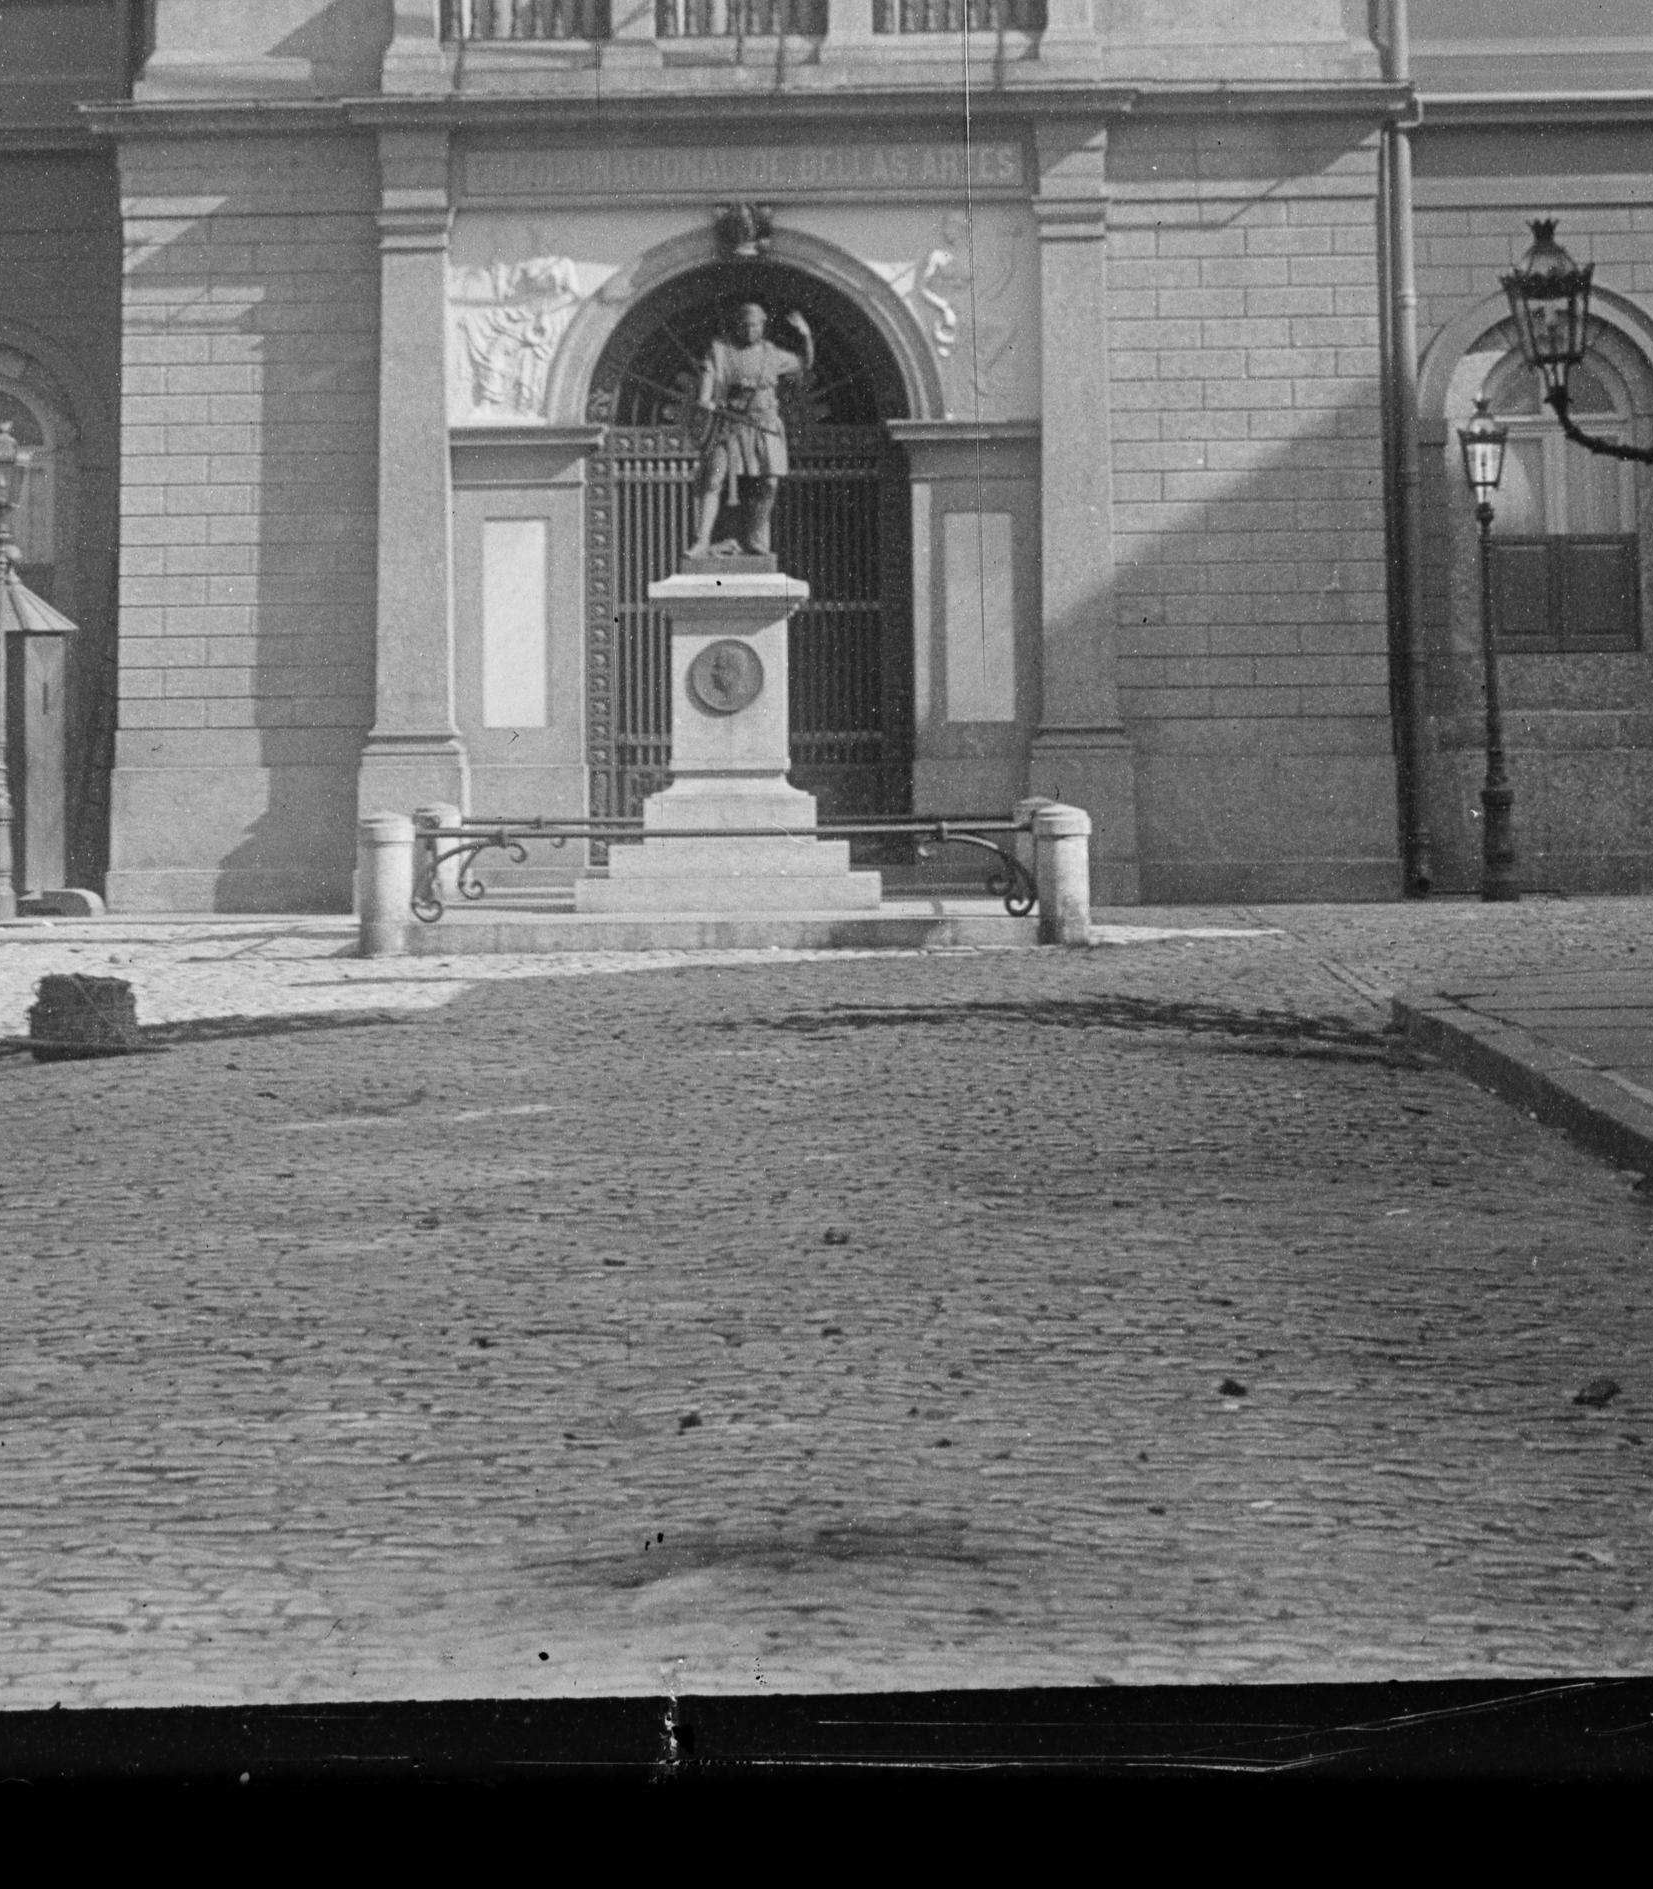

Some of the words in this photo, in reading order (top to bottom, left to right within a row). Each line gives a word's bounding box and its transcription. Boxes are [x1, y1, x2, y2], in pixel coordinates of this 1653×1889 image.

[588, 150, 737, 185] NACIONAL
[748, 149, 785, 183] DE
[798, 147, 909, 182] BELLAS
[920, 145, 1016, 180] ARTES
